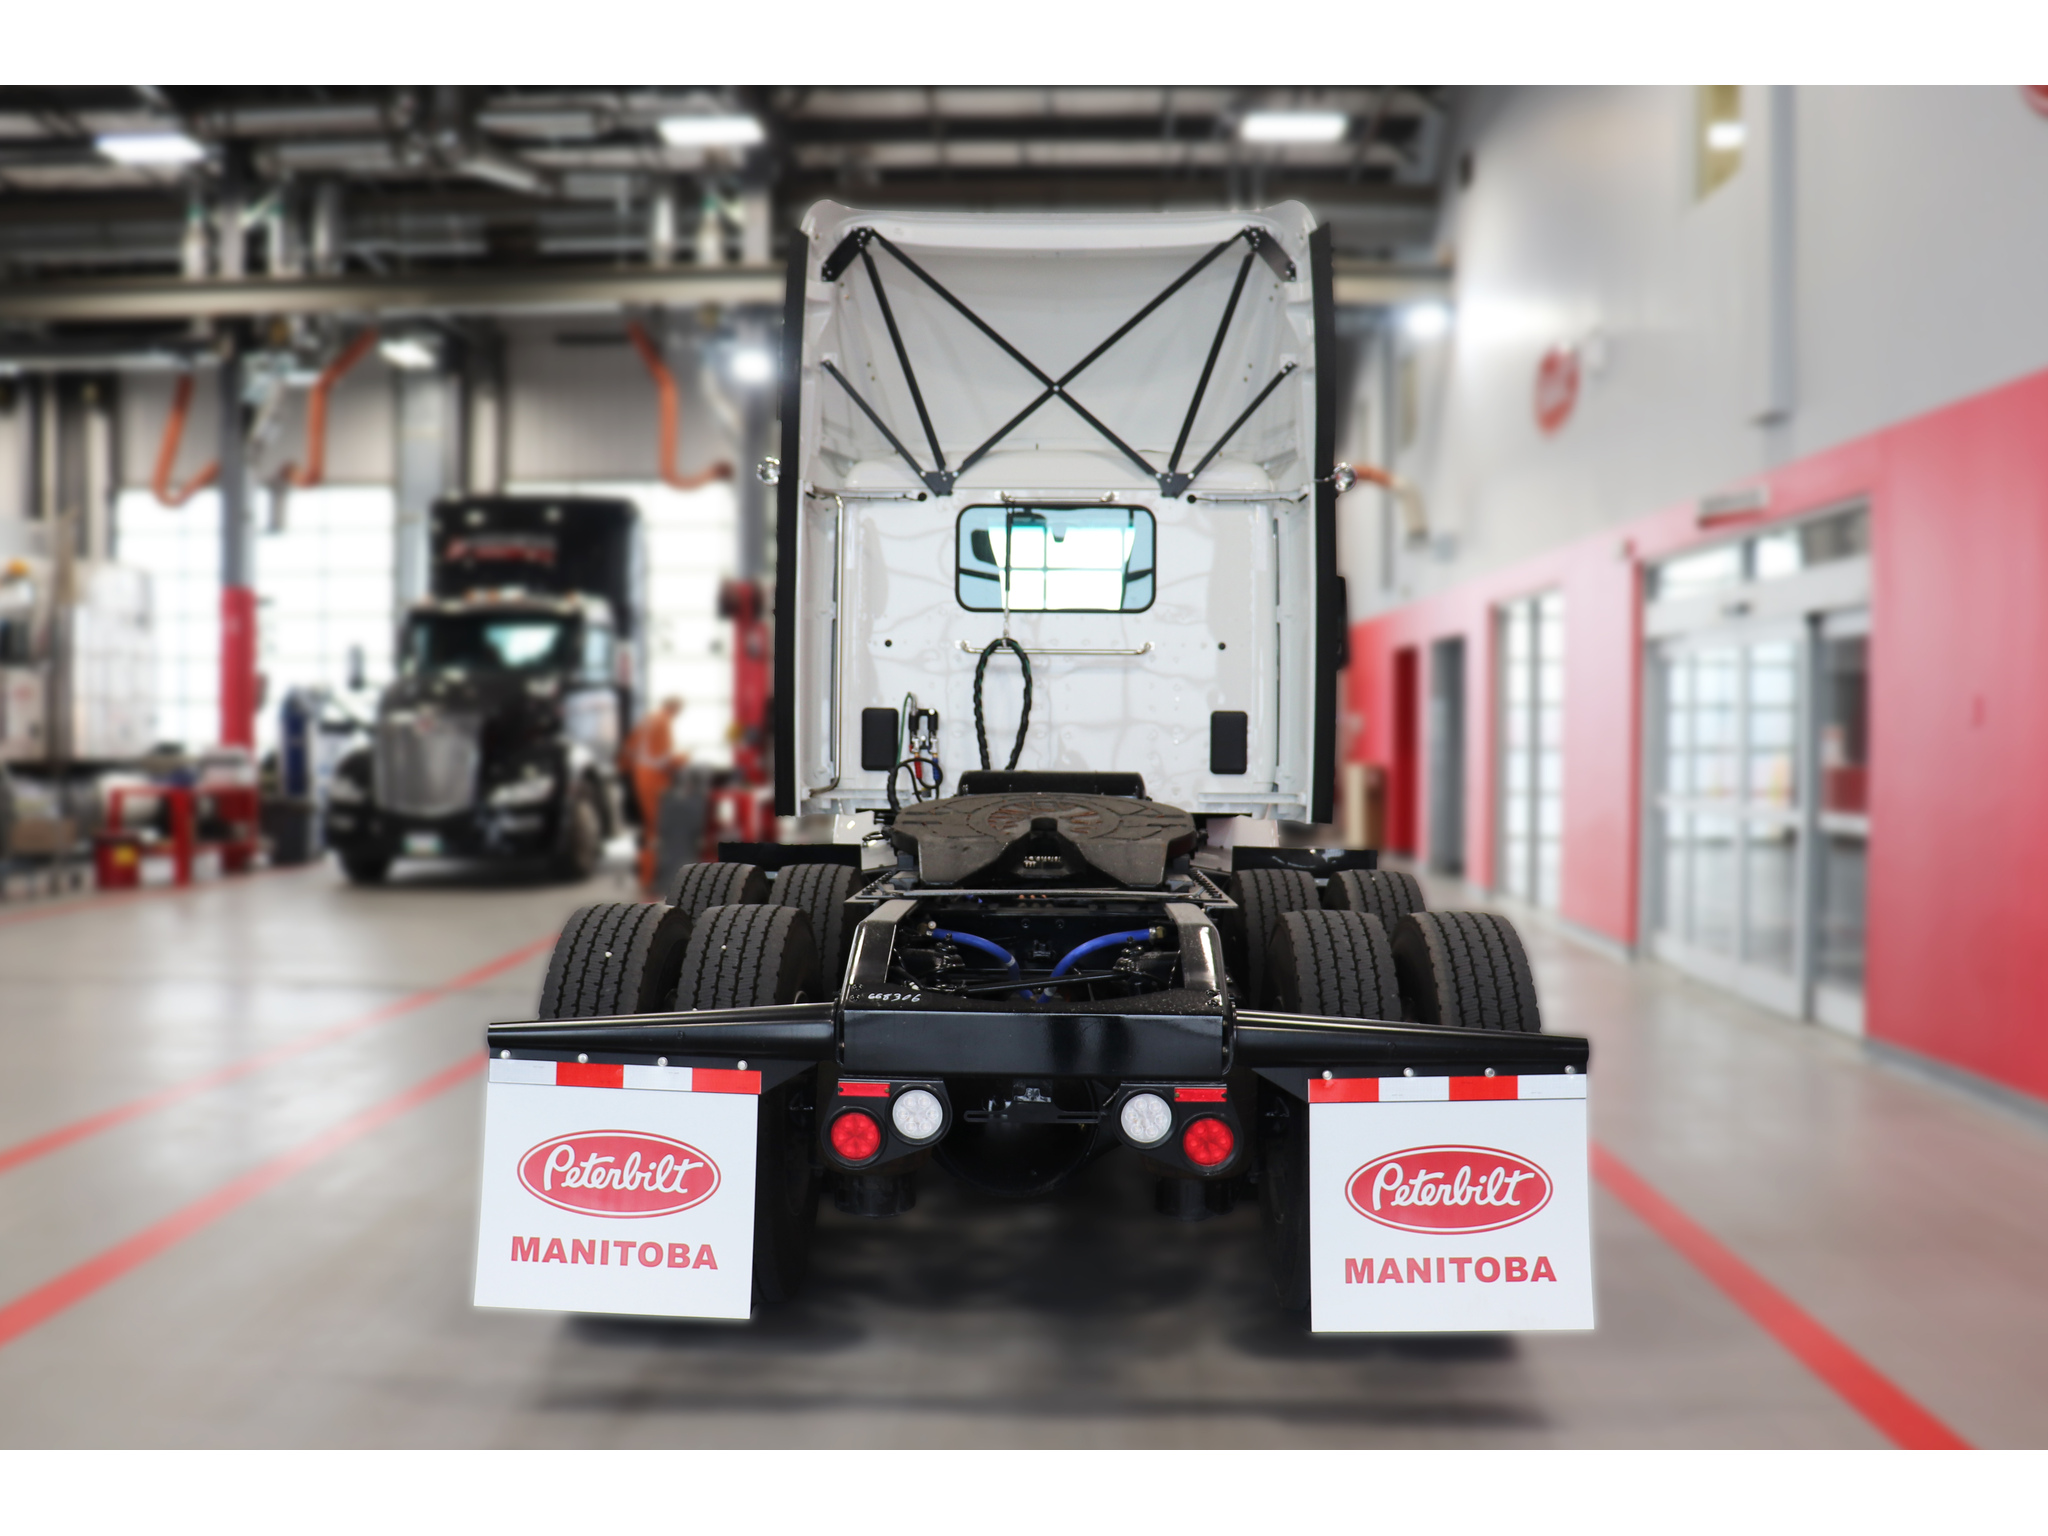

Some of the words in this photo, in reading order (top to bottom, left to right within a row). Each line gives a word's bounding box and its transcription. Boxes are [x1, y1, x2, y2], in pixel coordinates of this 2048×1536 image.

[542, 1143, 705, 1194] Peterbilt
[1372, 1162, 1536, 1212] Peterbilt
[510, 1236, 718, 1271] MANITOBA
[1344, 1256, 1558, 1285] MANITOBA
